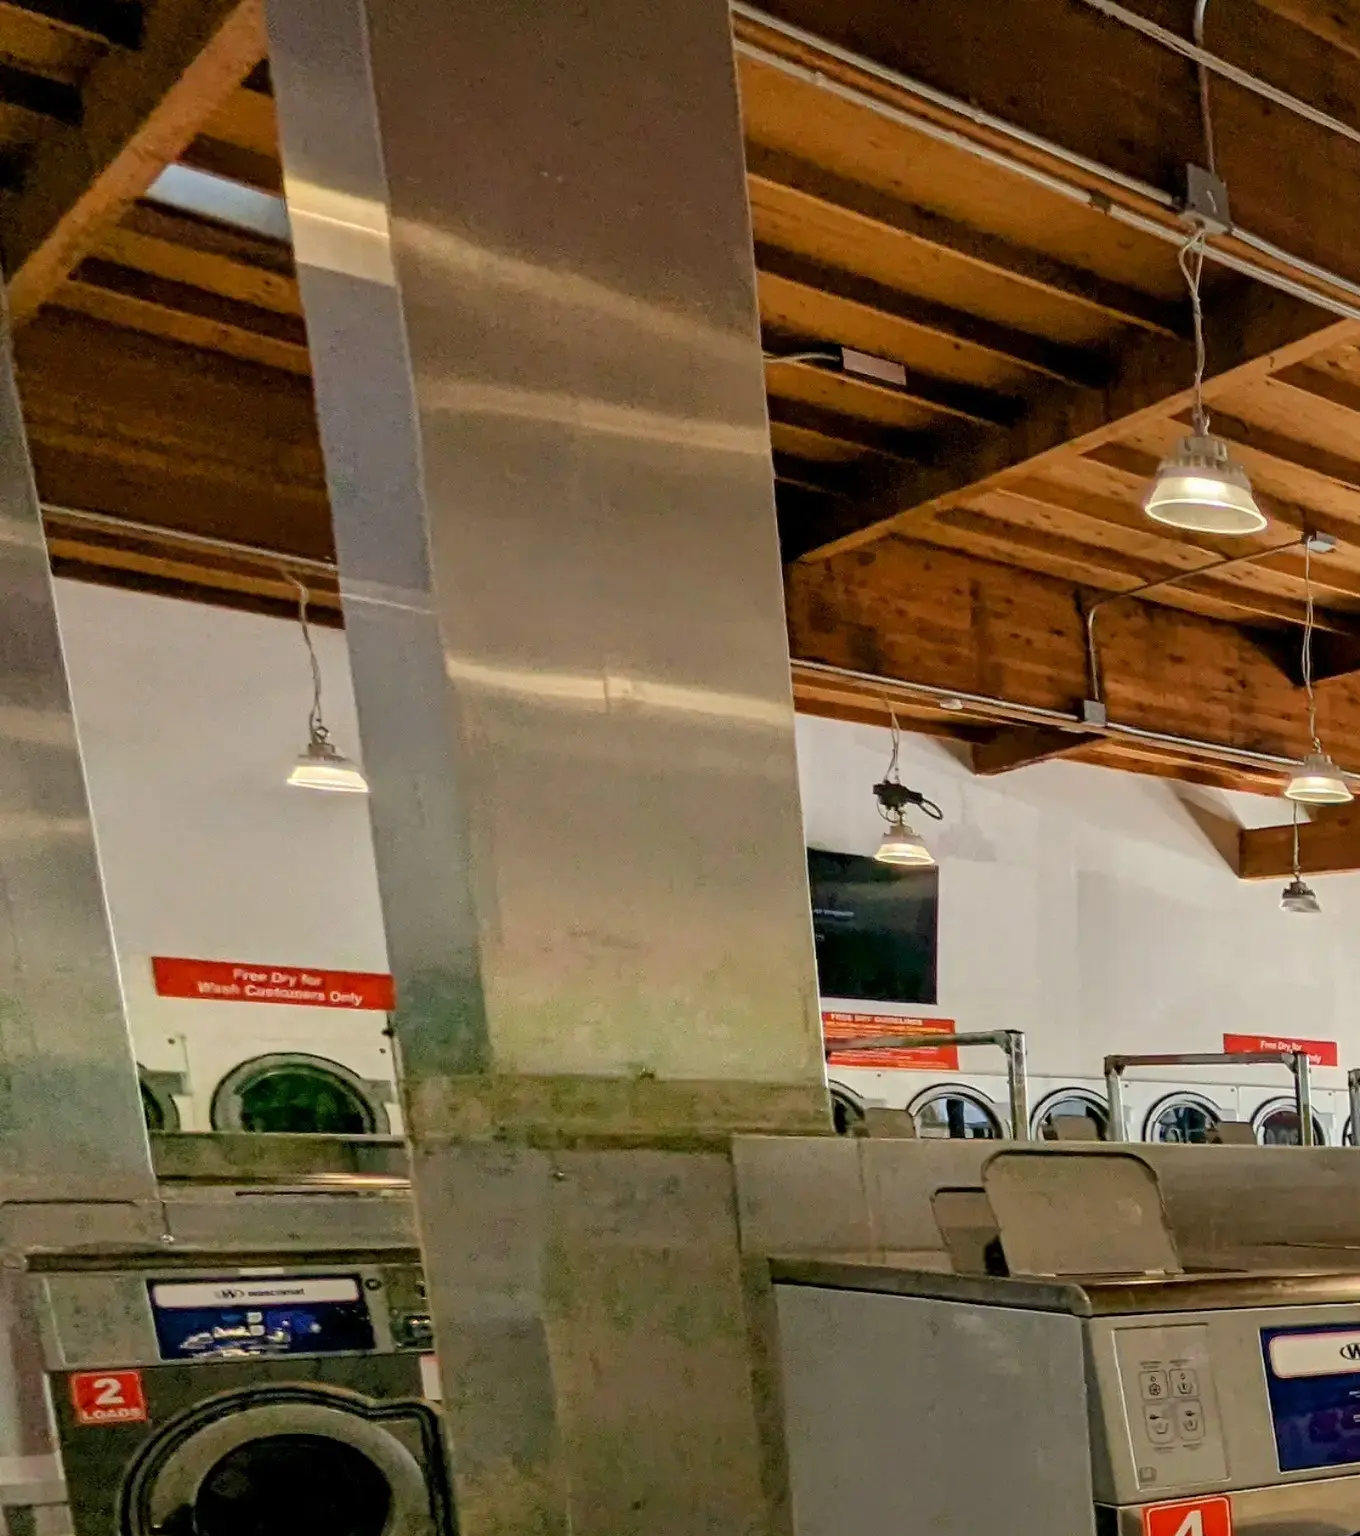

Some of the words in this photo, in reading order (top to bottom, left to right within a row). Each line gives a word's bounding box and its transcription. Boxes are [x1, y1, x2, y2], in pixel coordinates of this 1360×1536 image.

[232, 967, 268, 983] Free
[270, 972, 297, 988] Dry
[301, 973, 323, 987] for
[197, 980, 240, 996] Wash
[244, 983, 326, 1002] Customers
[329, 990, 363, 1006] Only
[1260, 1040, 1277, 1050] Free
[93, 1378, 125, 1405] 2
[81, 1406, 143, 1421] LOADS
